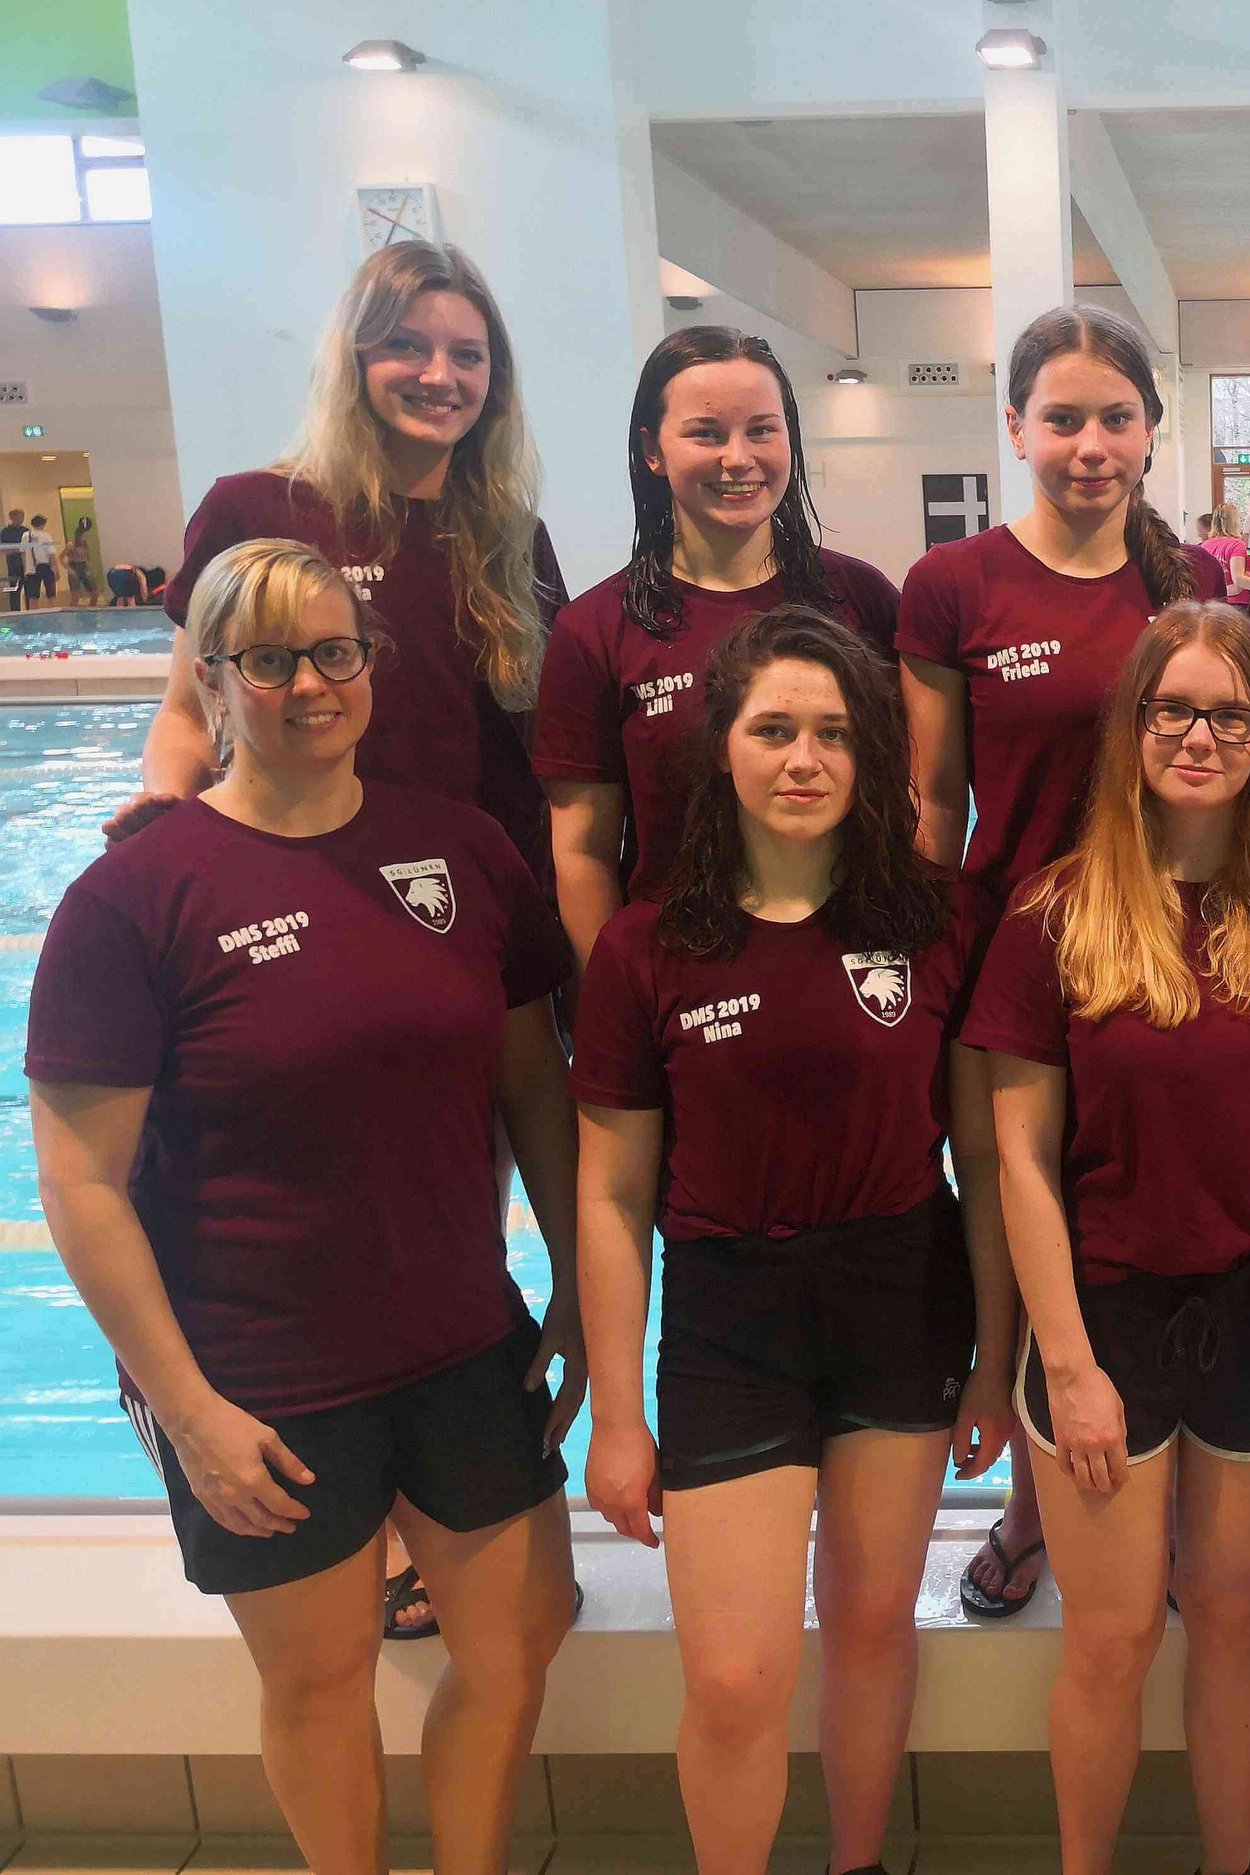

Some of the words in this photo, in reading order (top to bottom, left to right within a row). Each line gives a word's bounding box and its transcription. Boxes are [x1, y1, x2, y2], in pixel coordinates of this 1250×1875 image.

[341, 564, 385, 582] 2019
[987, 646, 1019, 669] DMS
[1020, 640, 1061, 659] 2019
[1001, 659, 1050, 682] Frieda
[656, 672, 694, 695] 2019
[646, 694, 674, 717] Lilli
[217, 923, 263, 953] DMS
[262, 911, 309, 937] 2019
[248, 934, 301, 965] Steffi
[679, 1004, 716, 1031] DMS
[717, 993, 761, 1019] 2019
[703, 1021, 742, 1044] Nina
